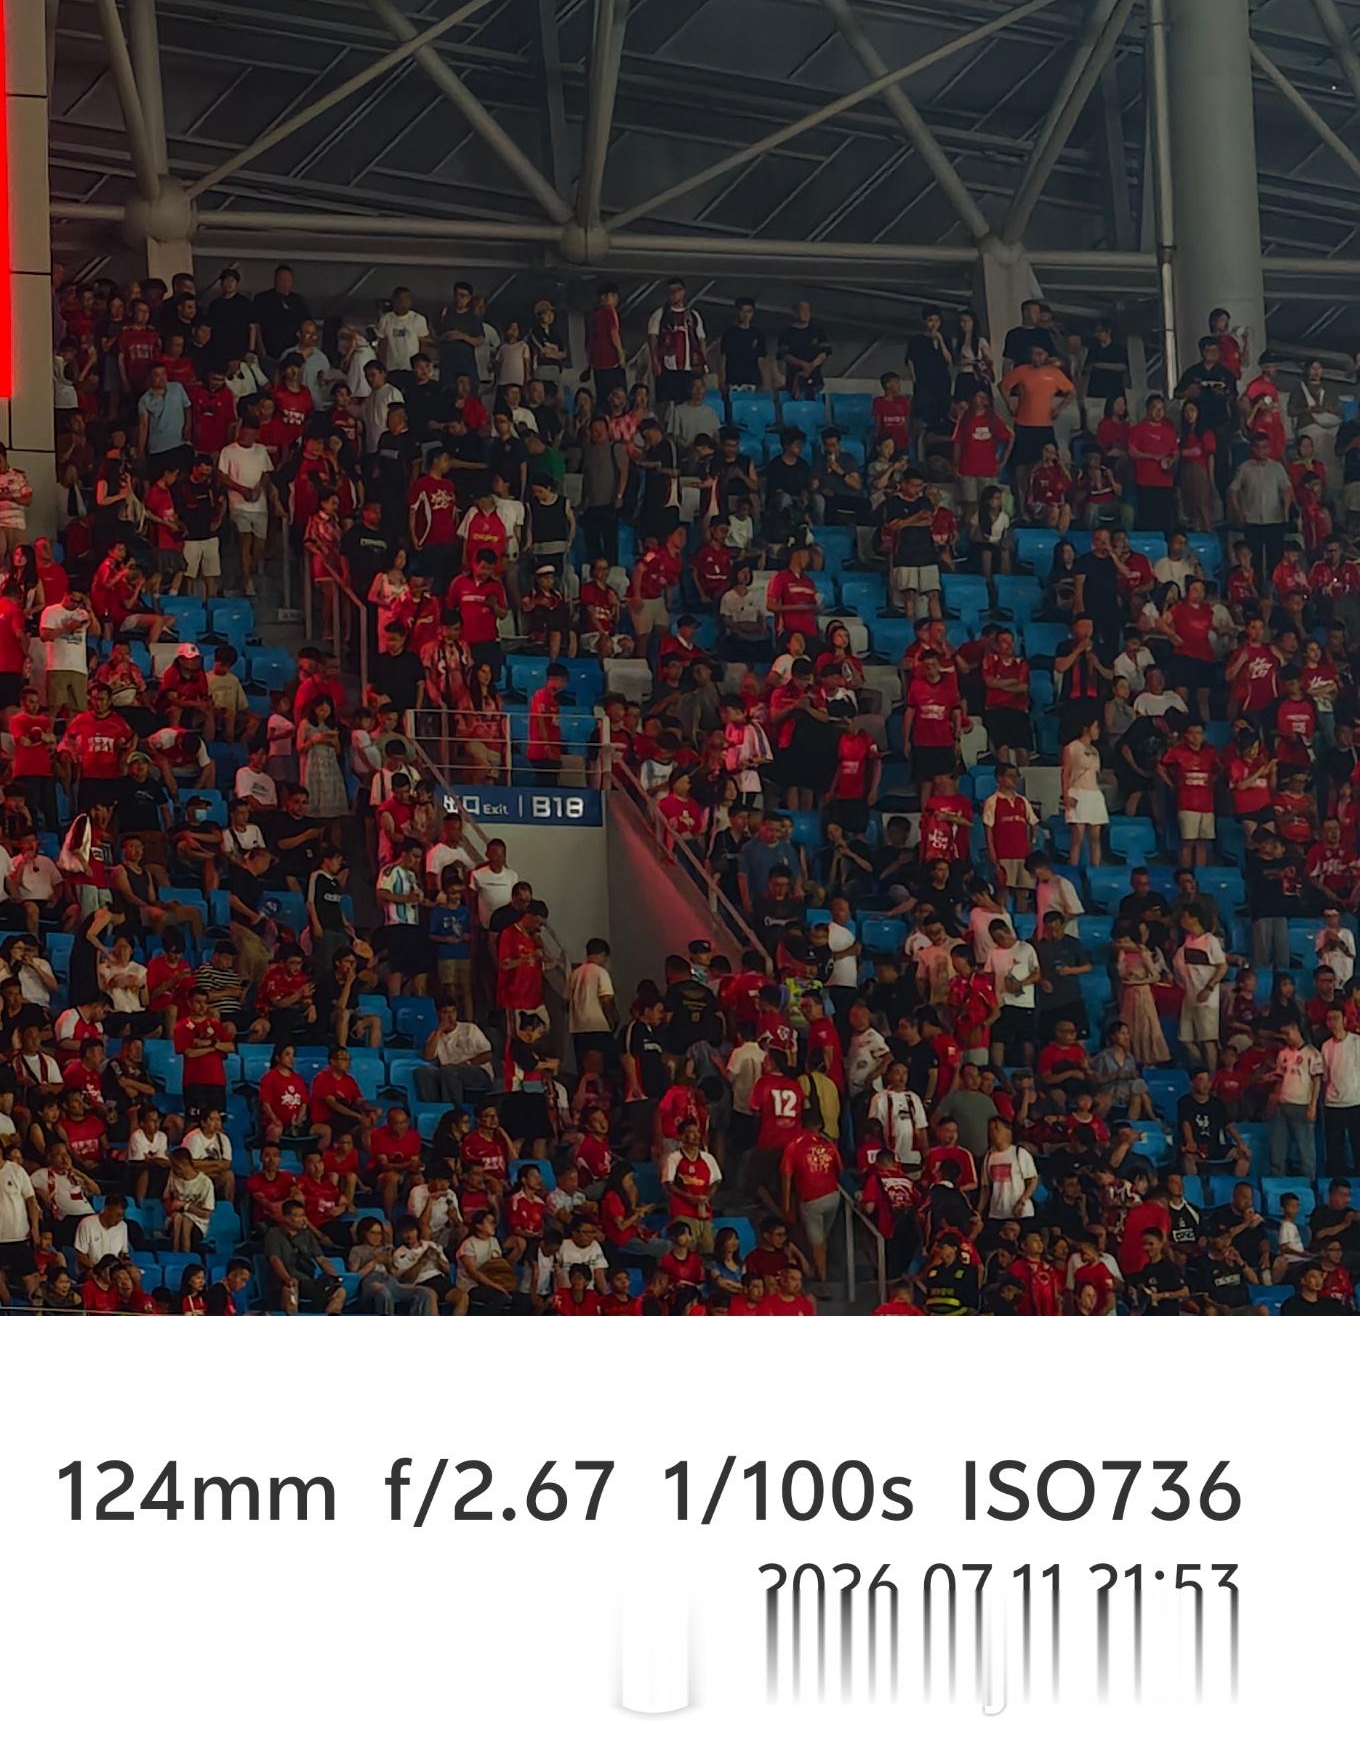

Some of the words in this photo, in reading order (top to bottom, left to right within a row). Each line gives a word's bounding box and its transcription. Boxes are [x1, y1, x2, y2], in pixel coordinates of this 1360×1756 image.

[482, 803, 509, 815] Exit
[532, 795, 584, 819] B18
[771, 1089, 797, 1117] 12
